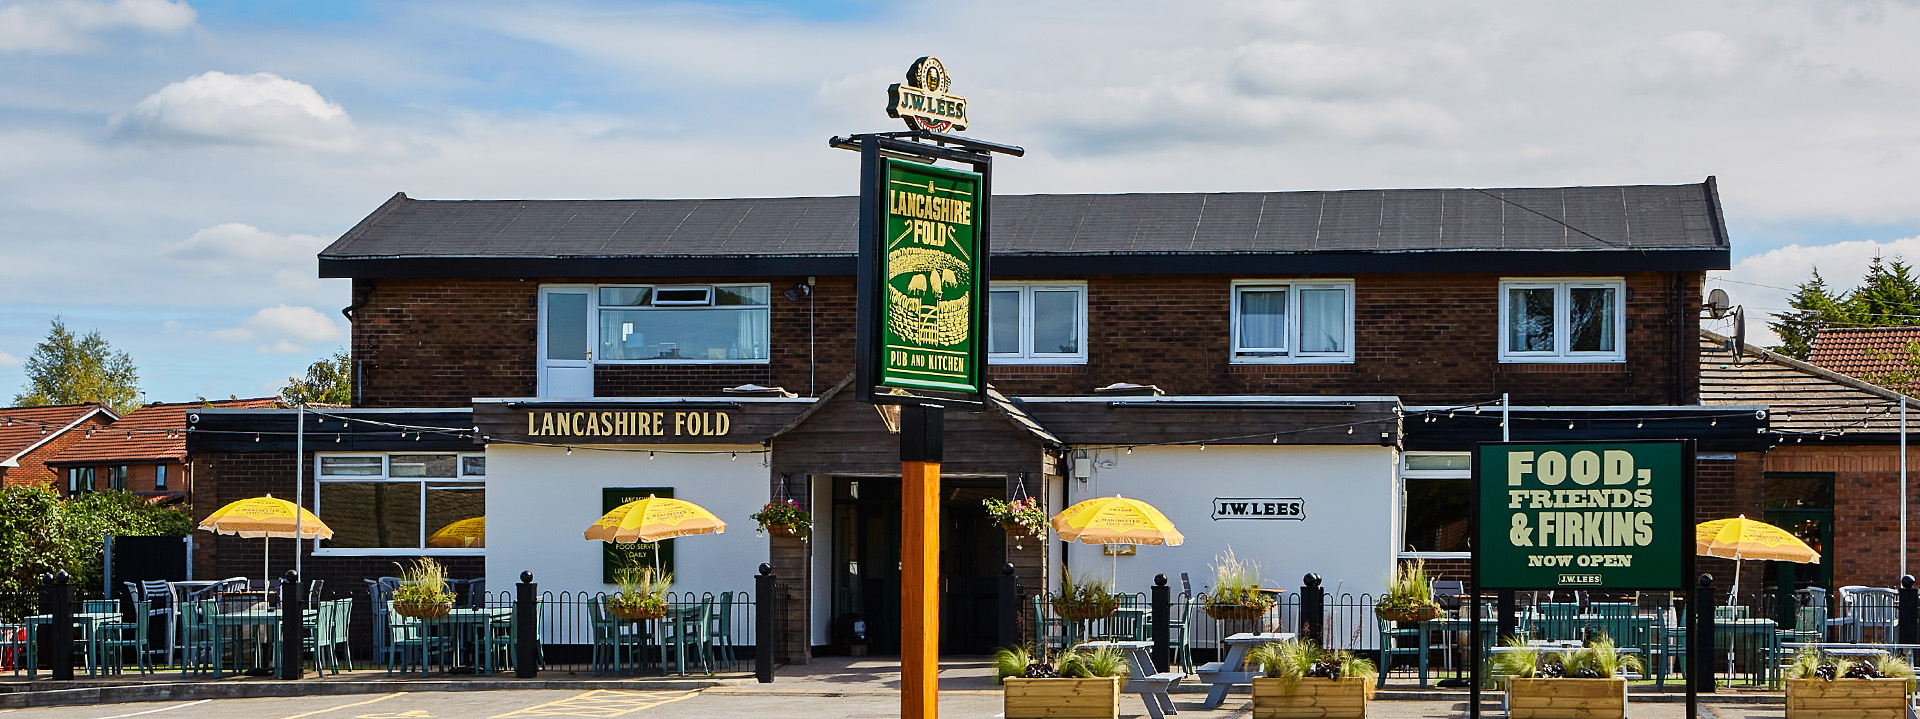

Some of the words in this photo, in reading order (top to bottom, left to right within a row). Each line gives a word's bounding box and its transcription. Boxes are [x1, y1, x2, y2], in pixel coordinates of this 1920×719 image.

[890, 190, 971, 225] LANCASHIRE
[914, 219, 947, 247] FOLD
[890, 350, 908, 366] PUB
[911, 354, 925, 367] AND
[928, 354, 964, 372] KITCHEN
[528, 412, 664, 436] LANCASHIRE
[675, 412, 730, 436] FOLD
[1508, 450, 1652, 486] FOOD,
[1508, 489, 1653, 509] FRIENDS
[1509, 512, 1534, 547] &
[1538, 511, 1653, 547] FIRKINS
[1528, 555, 1574, 567] NOW
[1577, 555, 1633, 567] OPEN
